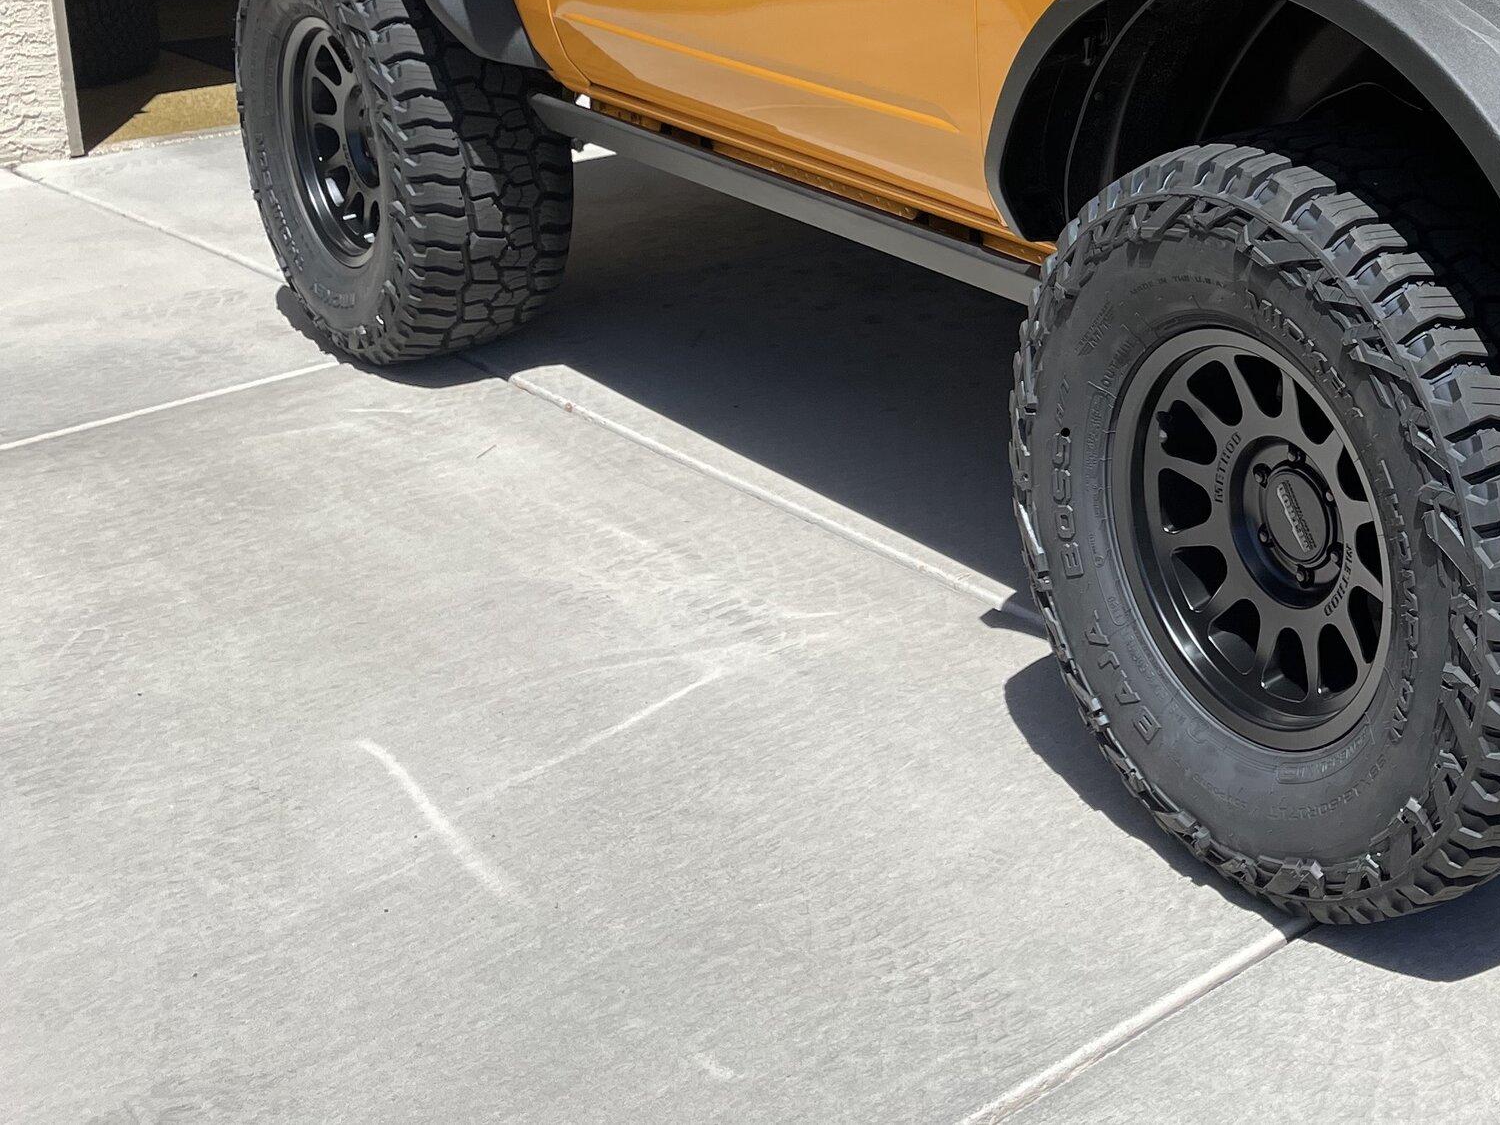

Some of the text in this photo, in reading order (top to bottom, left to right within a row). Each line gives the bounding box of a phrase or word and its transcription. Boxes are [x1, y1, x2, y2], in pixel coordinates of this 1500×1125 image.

[1051, 432, 1085, 579] BOSS
[1213, 431, 1242, 504] METHOD
[1323, 542, 1354, 617] METHOD
[1084, 609, 1162, 744] BAJA
